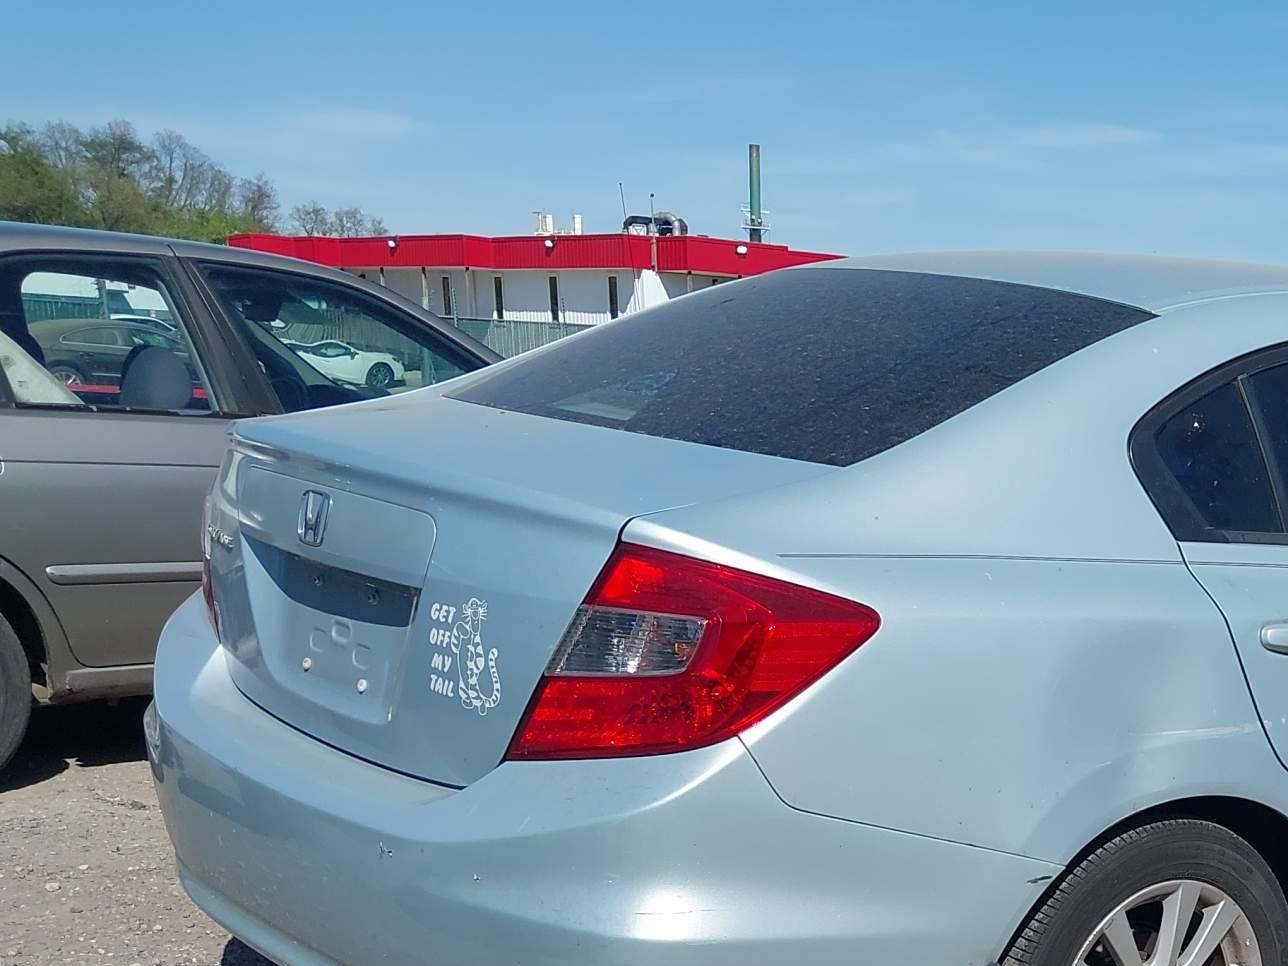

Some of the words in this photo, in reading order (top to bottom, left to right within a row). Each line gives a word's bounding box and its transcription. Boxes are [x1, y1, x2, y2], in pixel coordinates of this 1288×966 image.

[430, 602, 456, 624] GET
[430, 627, 451, 648] OFF
[431, 652, 452, 673] MY
[430, 673, 454, 697] TAIL
